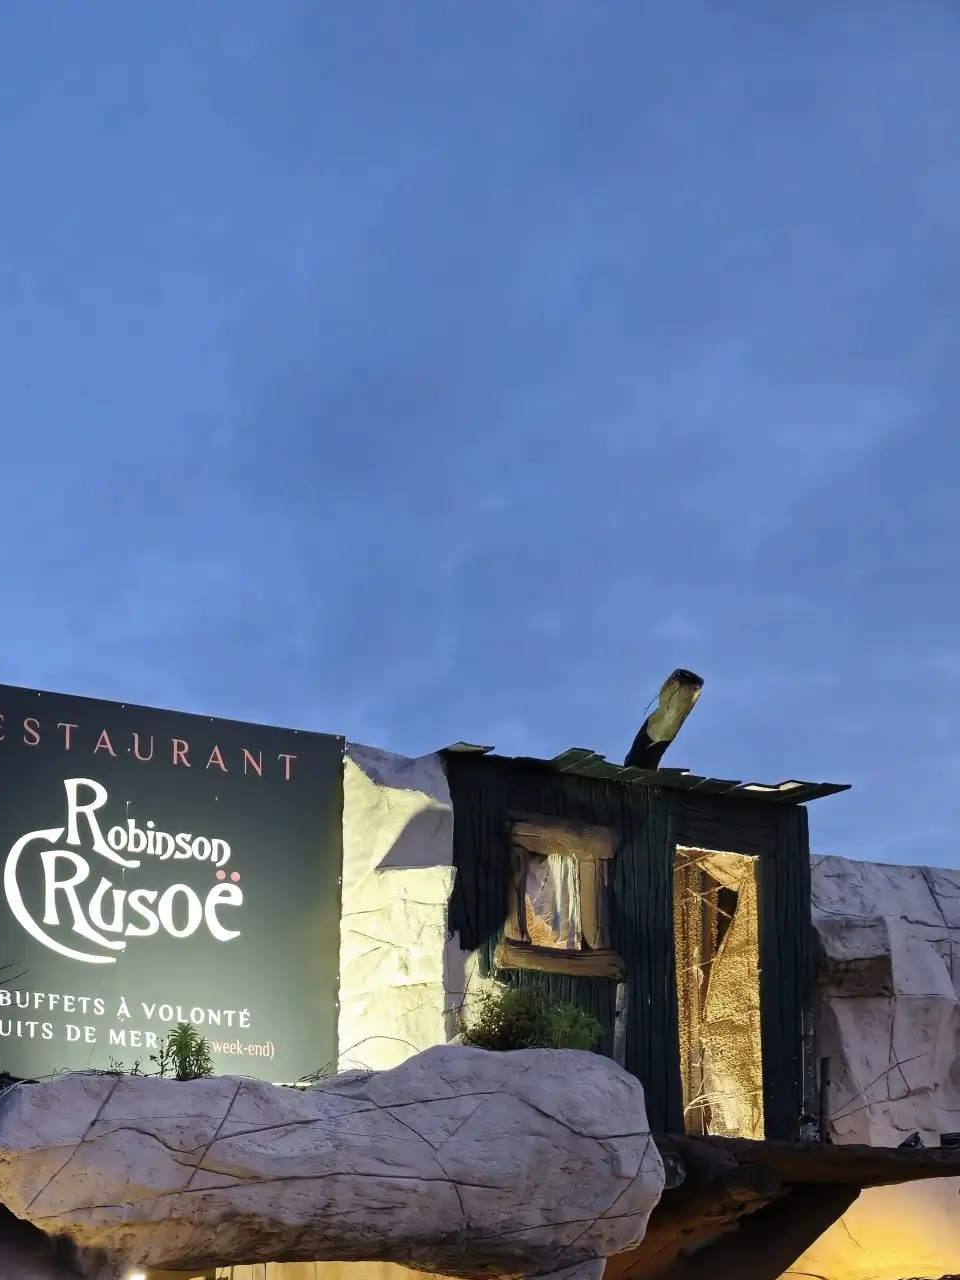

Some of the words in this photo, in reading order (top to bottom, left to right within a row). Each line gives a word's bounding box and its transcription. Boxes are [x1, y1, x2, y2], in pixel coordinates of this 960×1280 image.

[63, 777, 231, 868] Robinson
[116, 996, 131, 1018] À
[141, 1002, 251, 1028] VOLONTÉ
[65, 1024, 97, 1043] DE
[109, 1028, 158, 1049] MER
[212, 1040, 275, 1061] week-end)
